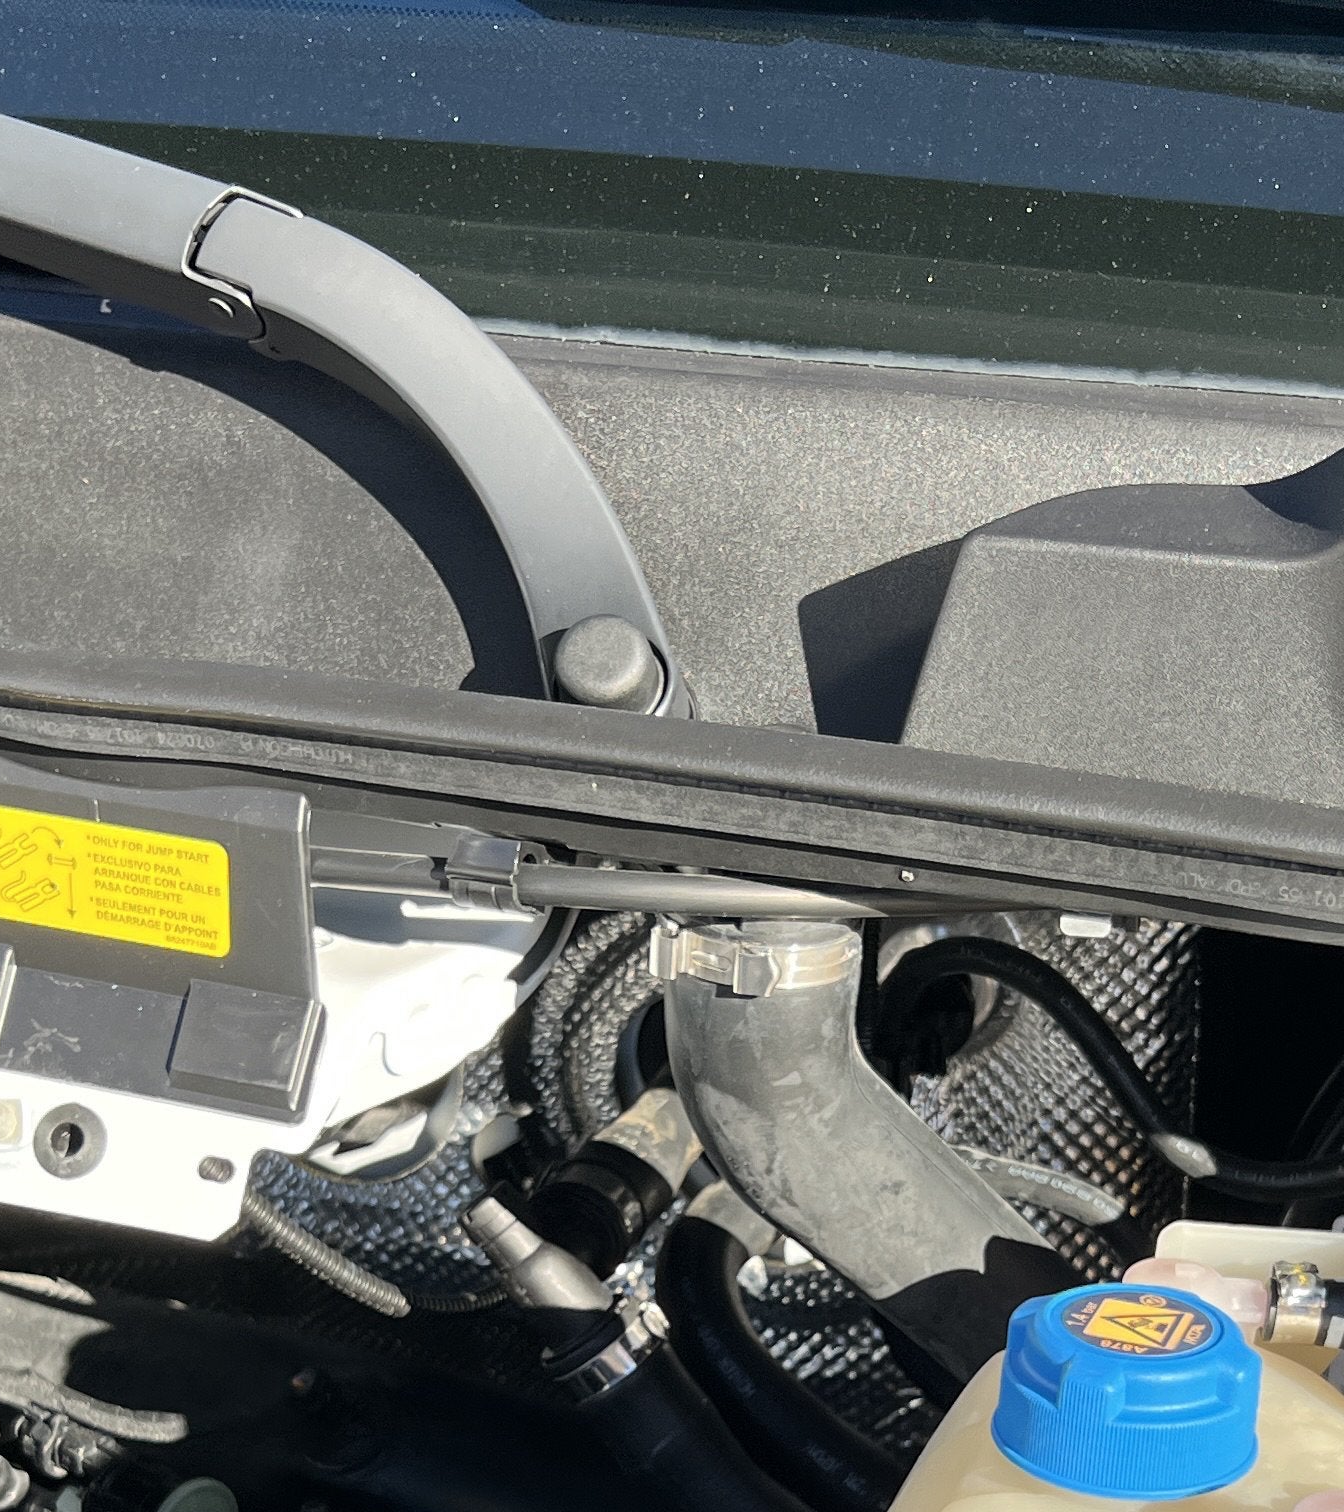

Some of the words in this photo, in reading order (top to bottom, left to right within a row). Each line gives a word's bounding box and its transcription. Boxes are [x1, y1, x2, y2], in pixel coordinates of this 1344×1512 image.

[92, 835, 119, 849] ONLY
[122, 840, 143, 852] FOR
[146, 845, 174, 857] JUMP
[177, 850, 209, 864] START
[93, 854, 151, 872] EXCLUSIVO
[154, 864, 182, 876] PARA
[94, 867, 151, 883] ARRANQUE
[154, 878, 177, 888] CON
[179, 882, 221, 896] CABLES
[95, 880, 122, 893] PASA
[124, 885, 183, 904] CORRIENTE
[96, 898, 156, 916] SEULEMENT
[160, 909, 188, 921] POUR
[191, 914, 206, 924] UN
[97, 910, 161, 929] DÉMARRAGE
[164, 922, 218, 939] D'APPOINT
